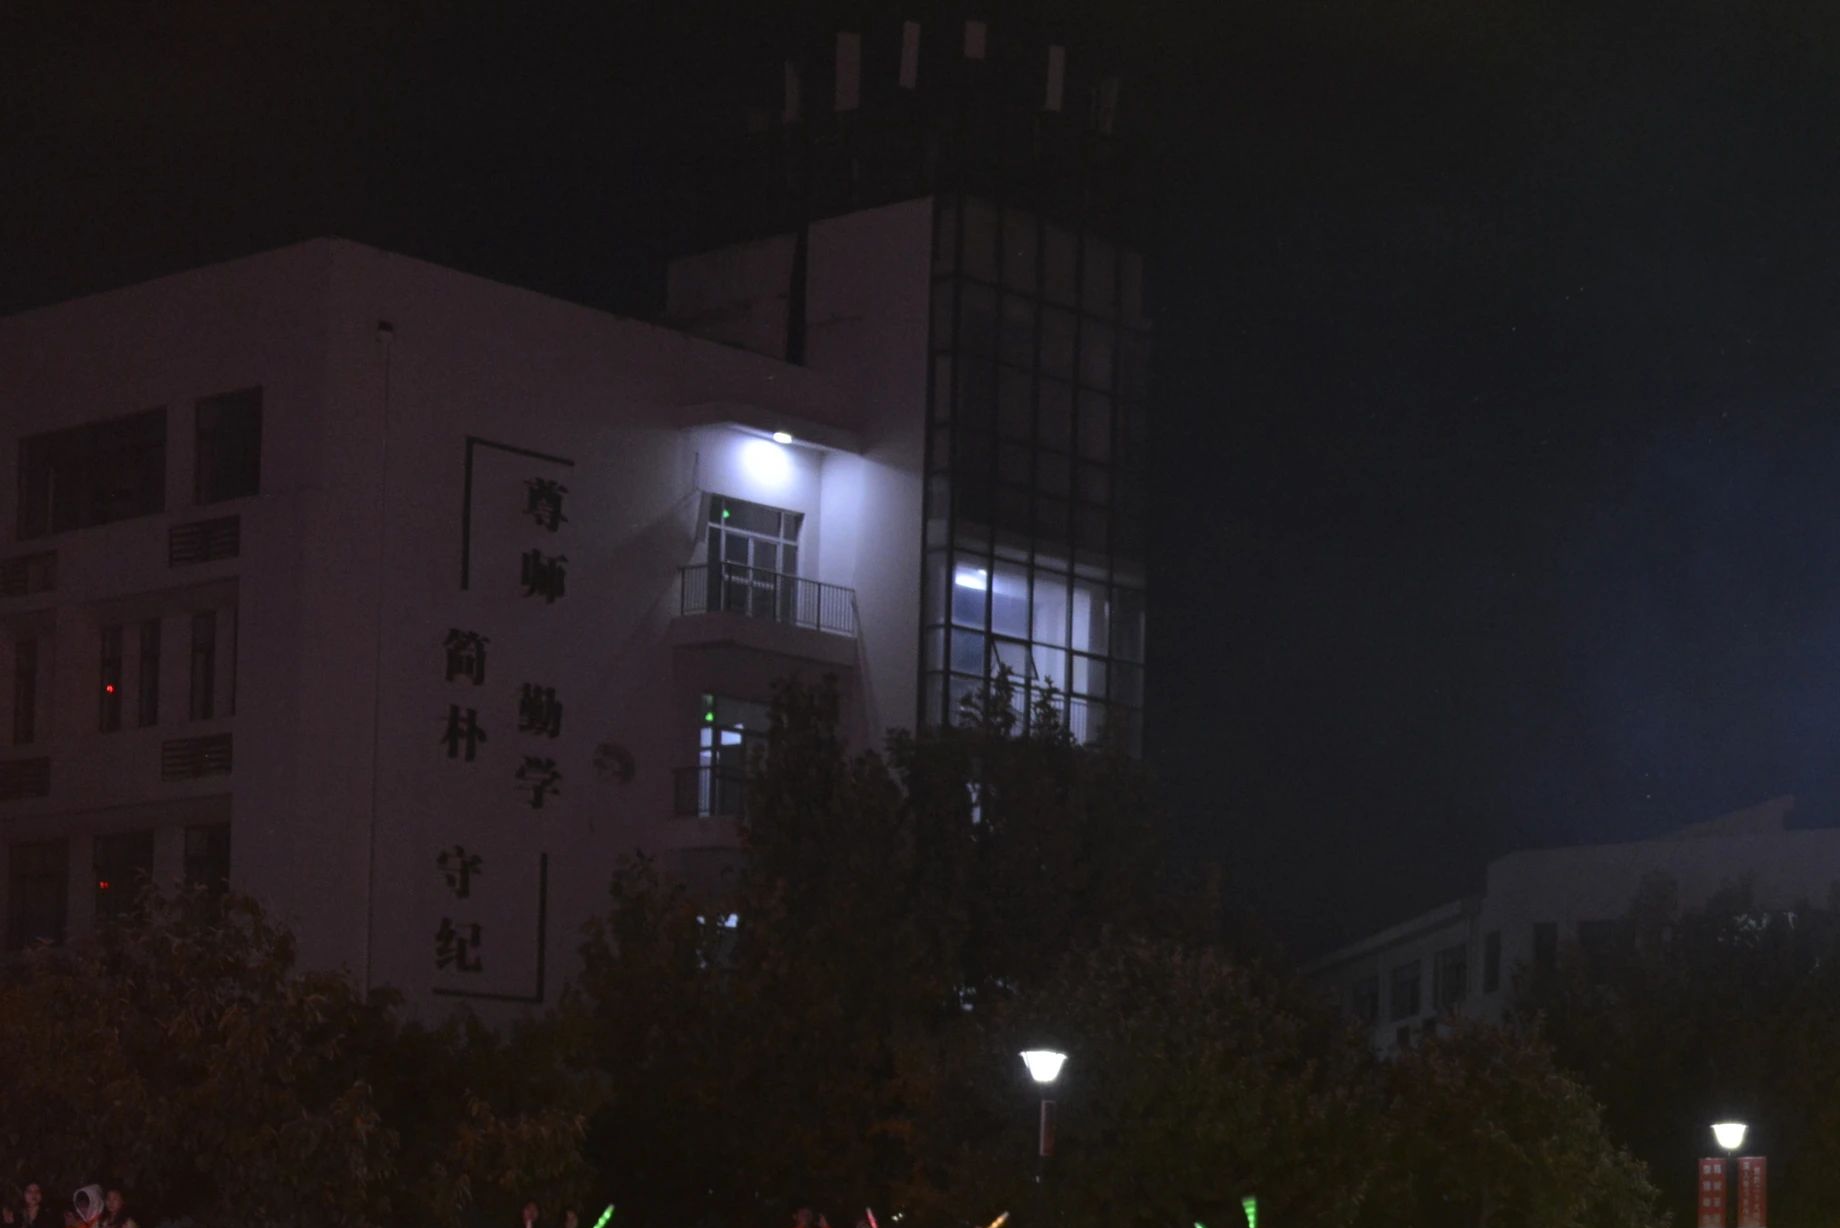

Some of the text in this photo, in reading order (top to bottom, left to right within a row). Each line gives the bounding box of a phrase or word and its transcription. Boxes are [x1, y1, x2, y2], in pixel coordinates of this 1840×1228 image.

[435, 628, 491, 973] 简朴 守纪
[514, 477, 568, 809] 尊师 勤学
